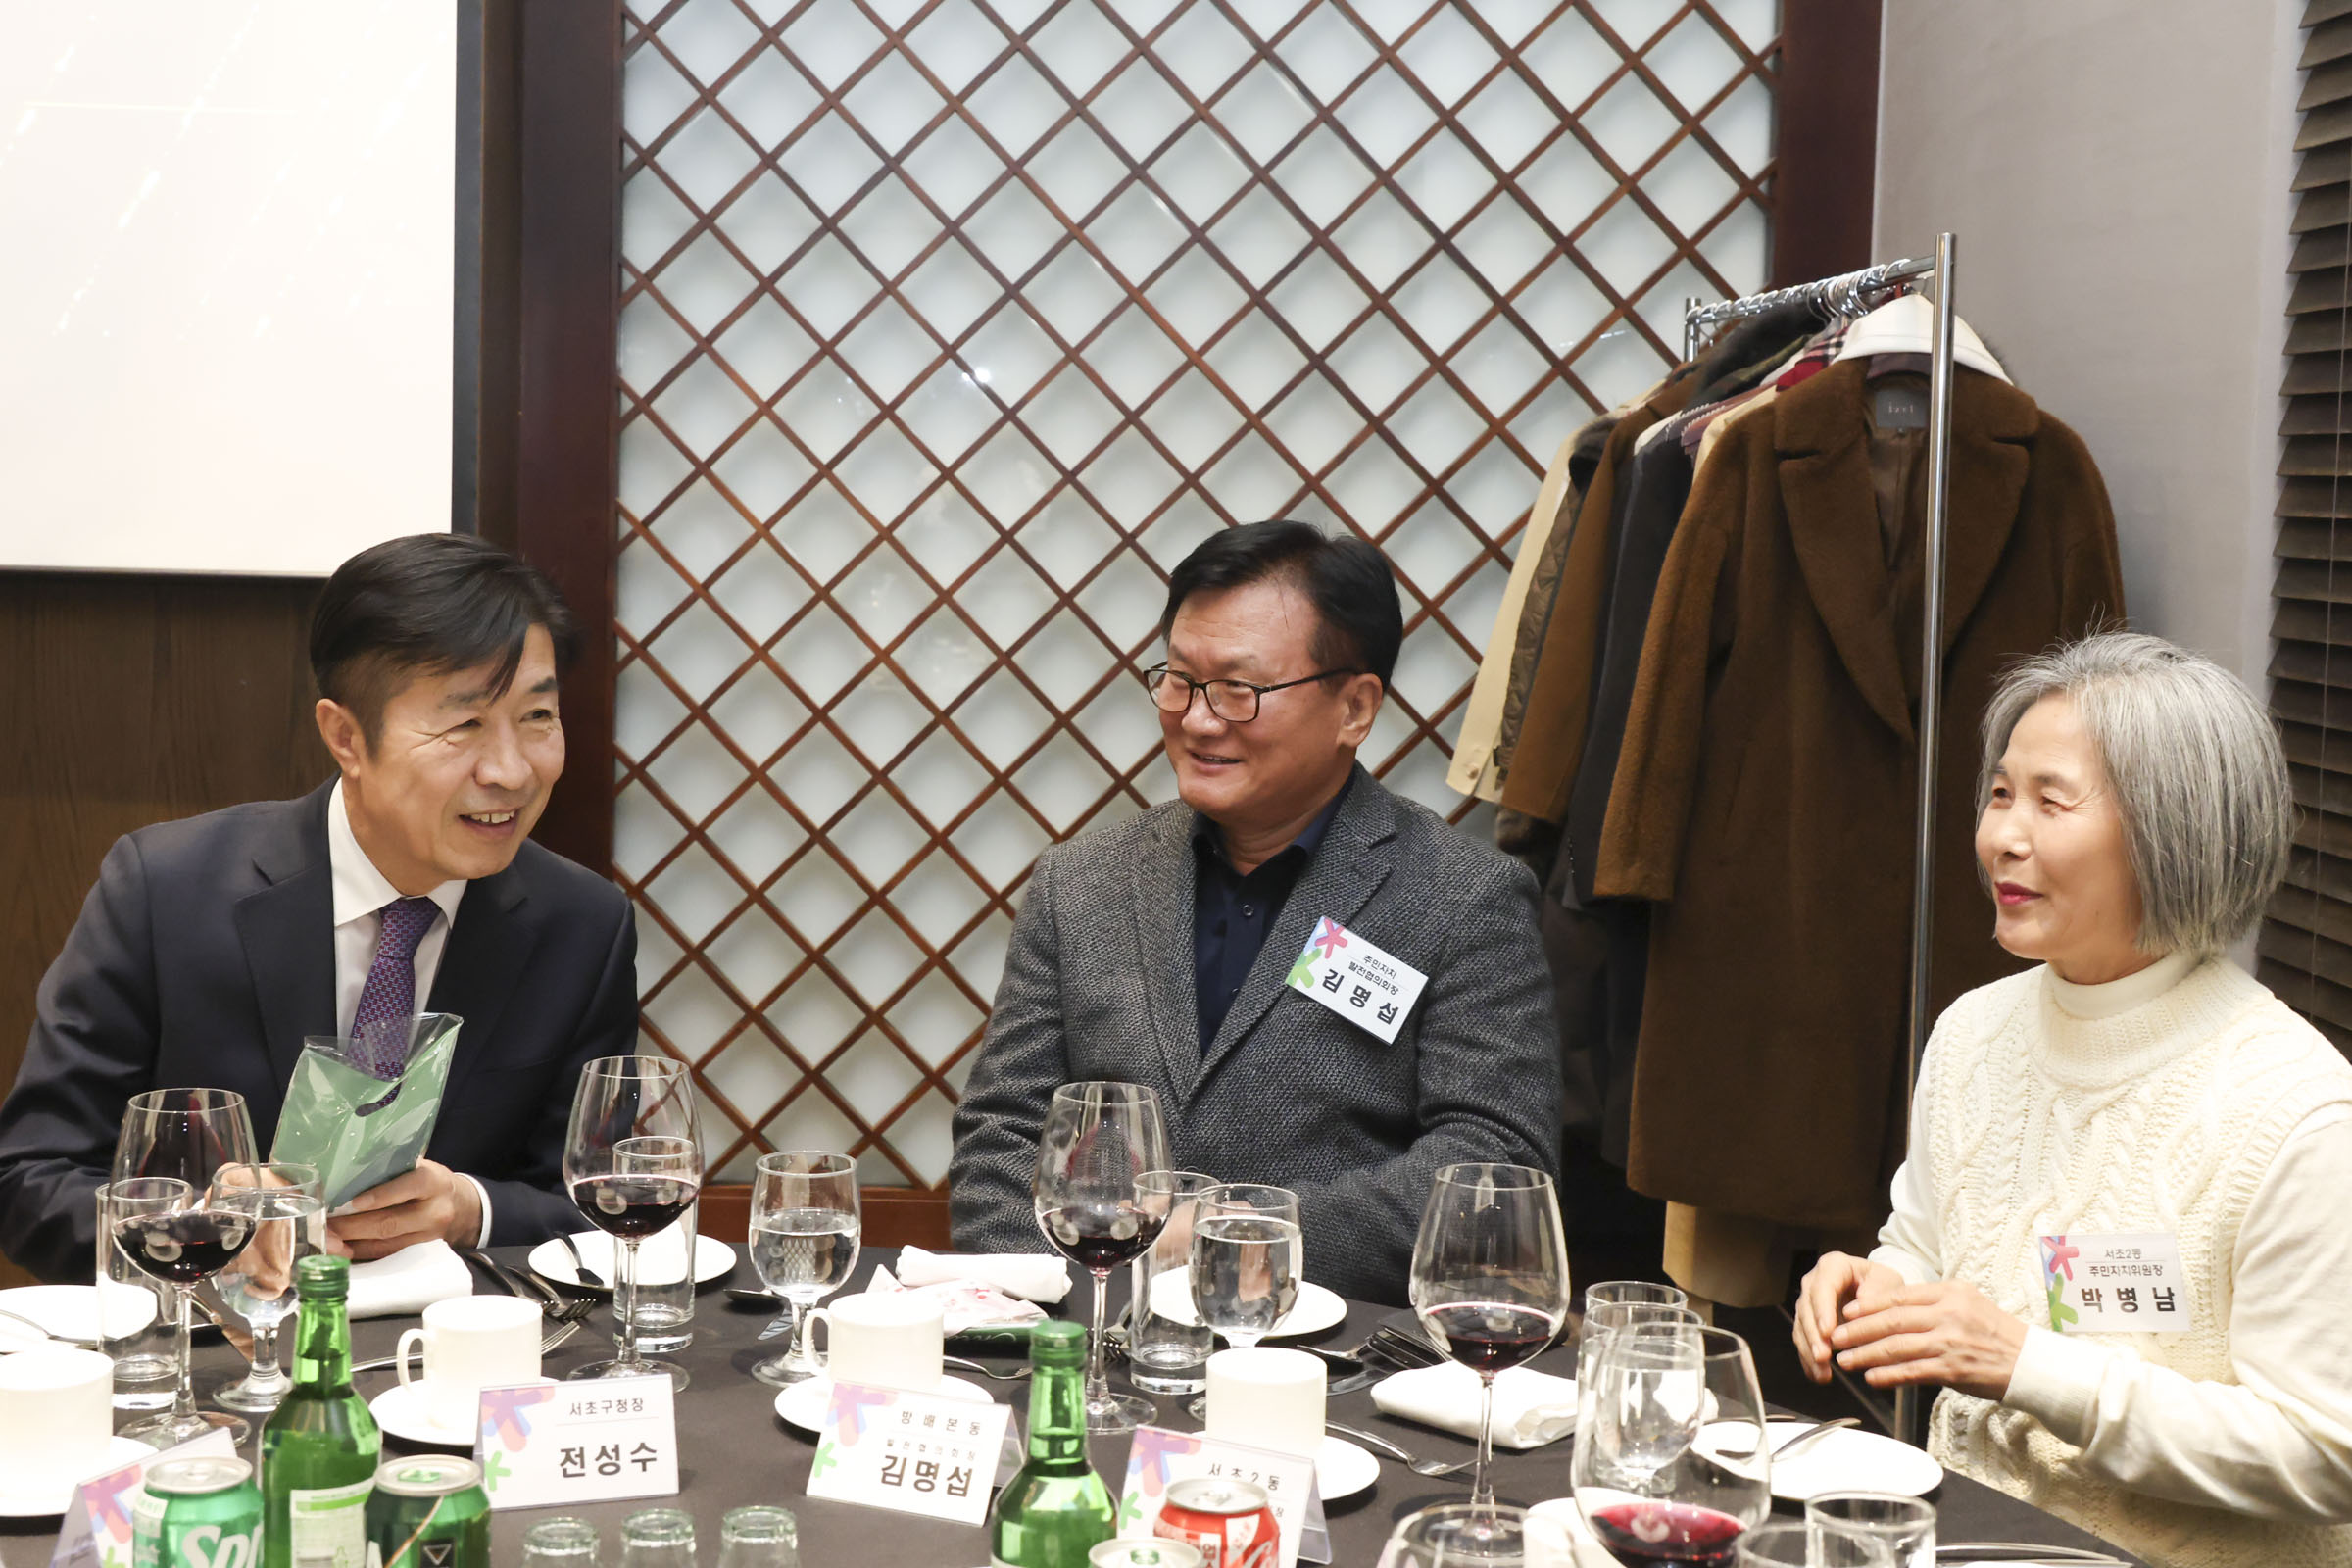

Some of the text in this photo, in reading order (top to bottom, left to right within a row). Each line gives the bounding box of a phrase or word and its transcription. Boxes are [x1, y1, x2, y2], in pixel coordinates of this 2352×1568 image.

[1348, 961, 1399, 995] 발전협의회장
[1363, 955, 1396, 979] 주민자치
[1322, 969, 1399, 1025] 김명섭
[2104, 1248, 2142, 1260] 서초2동
[2088, 1264, 2163, 1277] 주민자치위원장
[2081, 1287, 2176, 1313] 박병남
[569, 1397, 644, 1416] 서초구청장
[901, 1411, 981, 1436] 방배본동
[559, 1442, 658, 1478] 전성수
[881, 1454, 973, 1497] 김명섭
